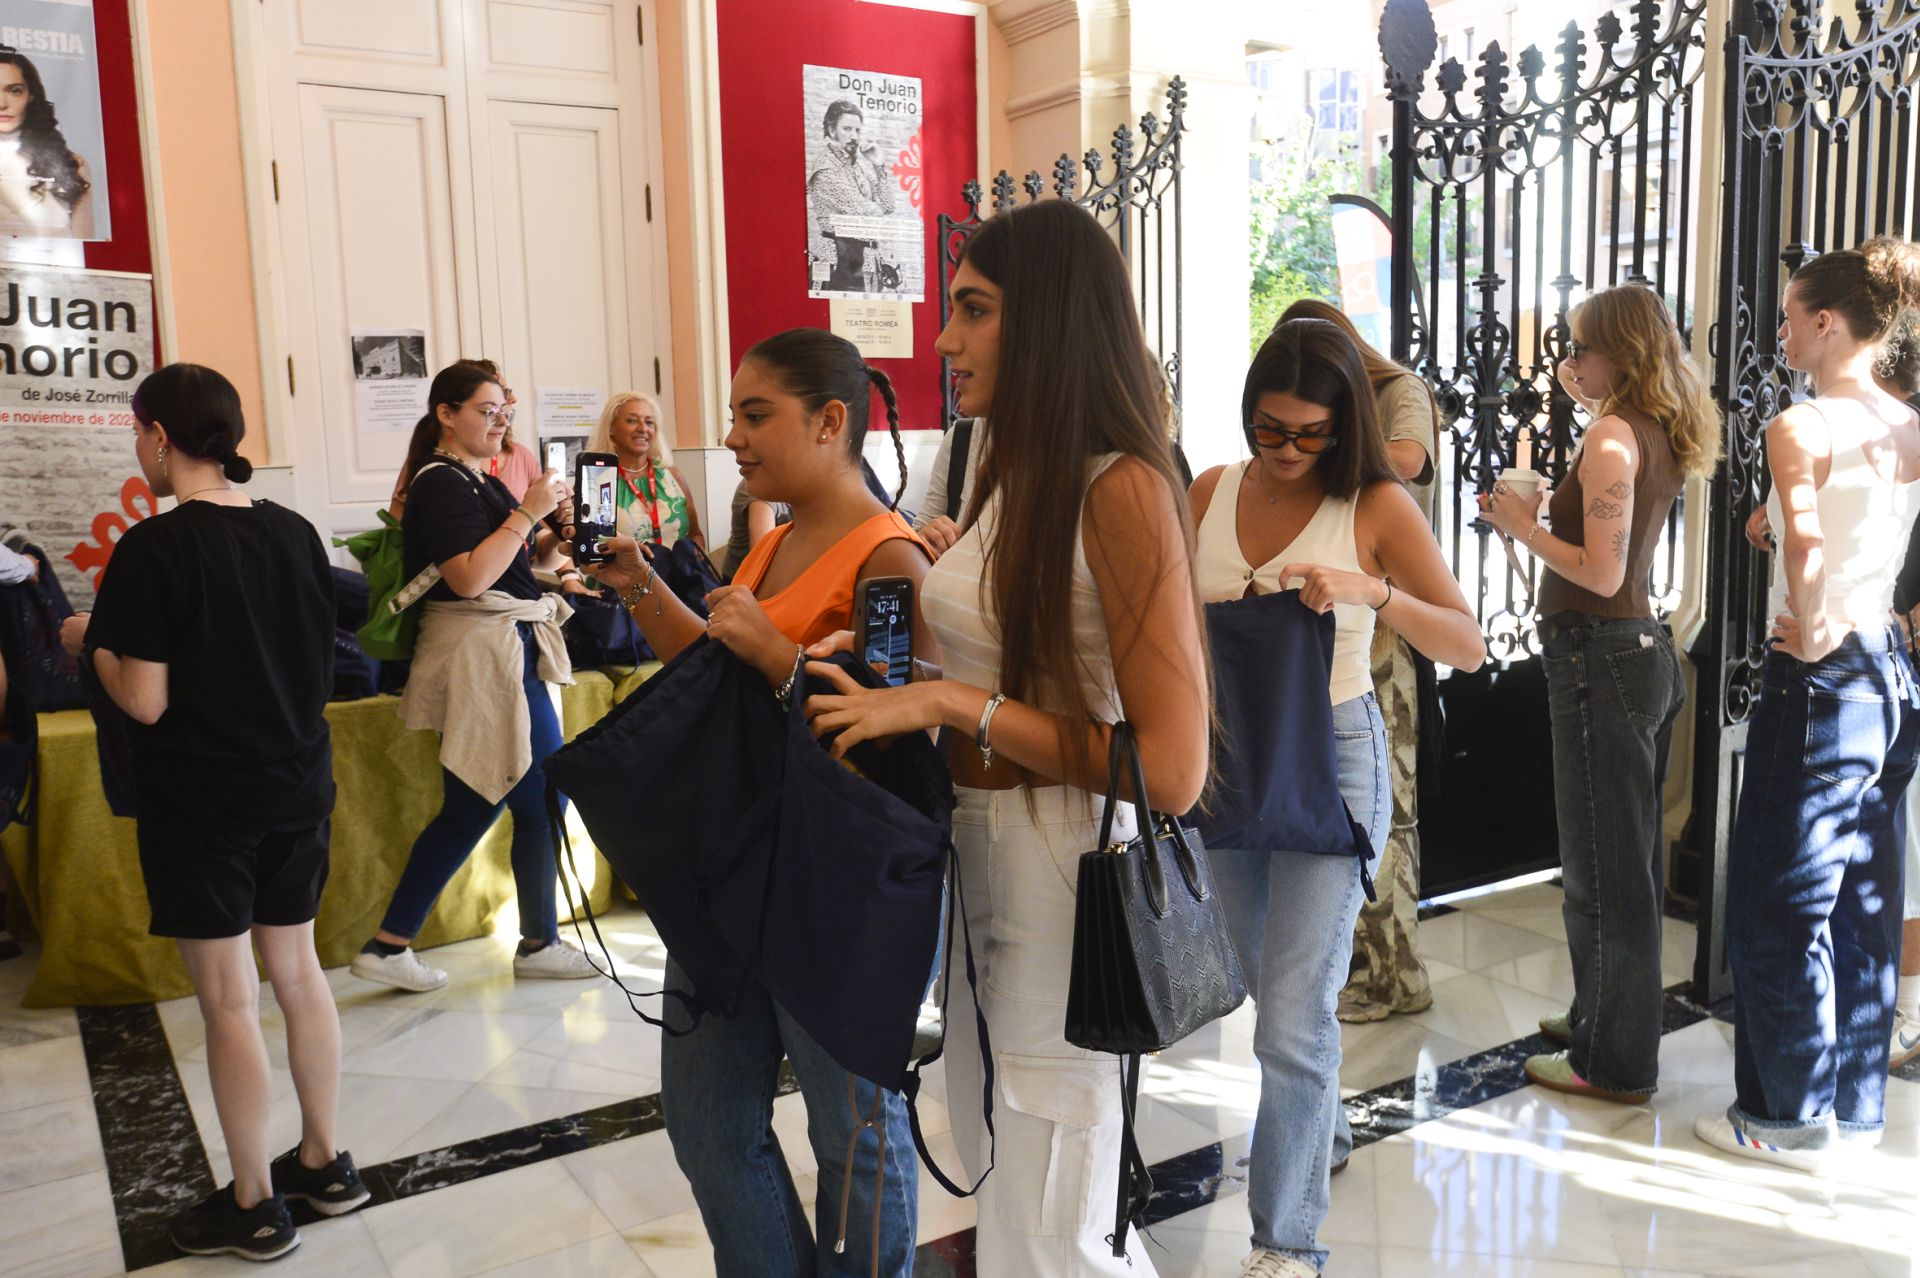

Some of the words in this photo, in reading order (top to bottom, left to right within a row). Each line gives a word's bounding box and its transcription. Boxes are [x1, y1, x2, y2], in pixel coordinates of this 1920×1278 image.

[2, 26, 85, 54] BESTIA
[839, 73, 873, 92] Don
[878, 79, 917, 97] Juan
[856, 92, 917, 115] Tenorio
[0, 282, 137, 333] Juan
[845, 319, 873, 327] TEATRO
[874, 320, 899, 328] ROMEA
[22, 388, 41, 401] de
[45, 388, 82, 402] José
[13, 410, 84, 425] noviembre
[88, 413, 105, 425] de
[877, 599, 900, 614] 17:41
